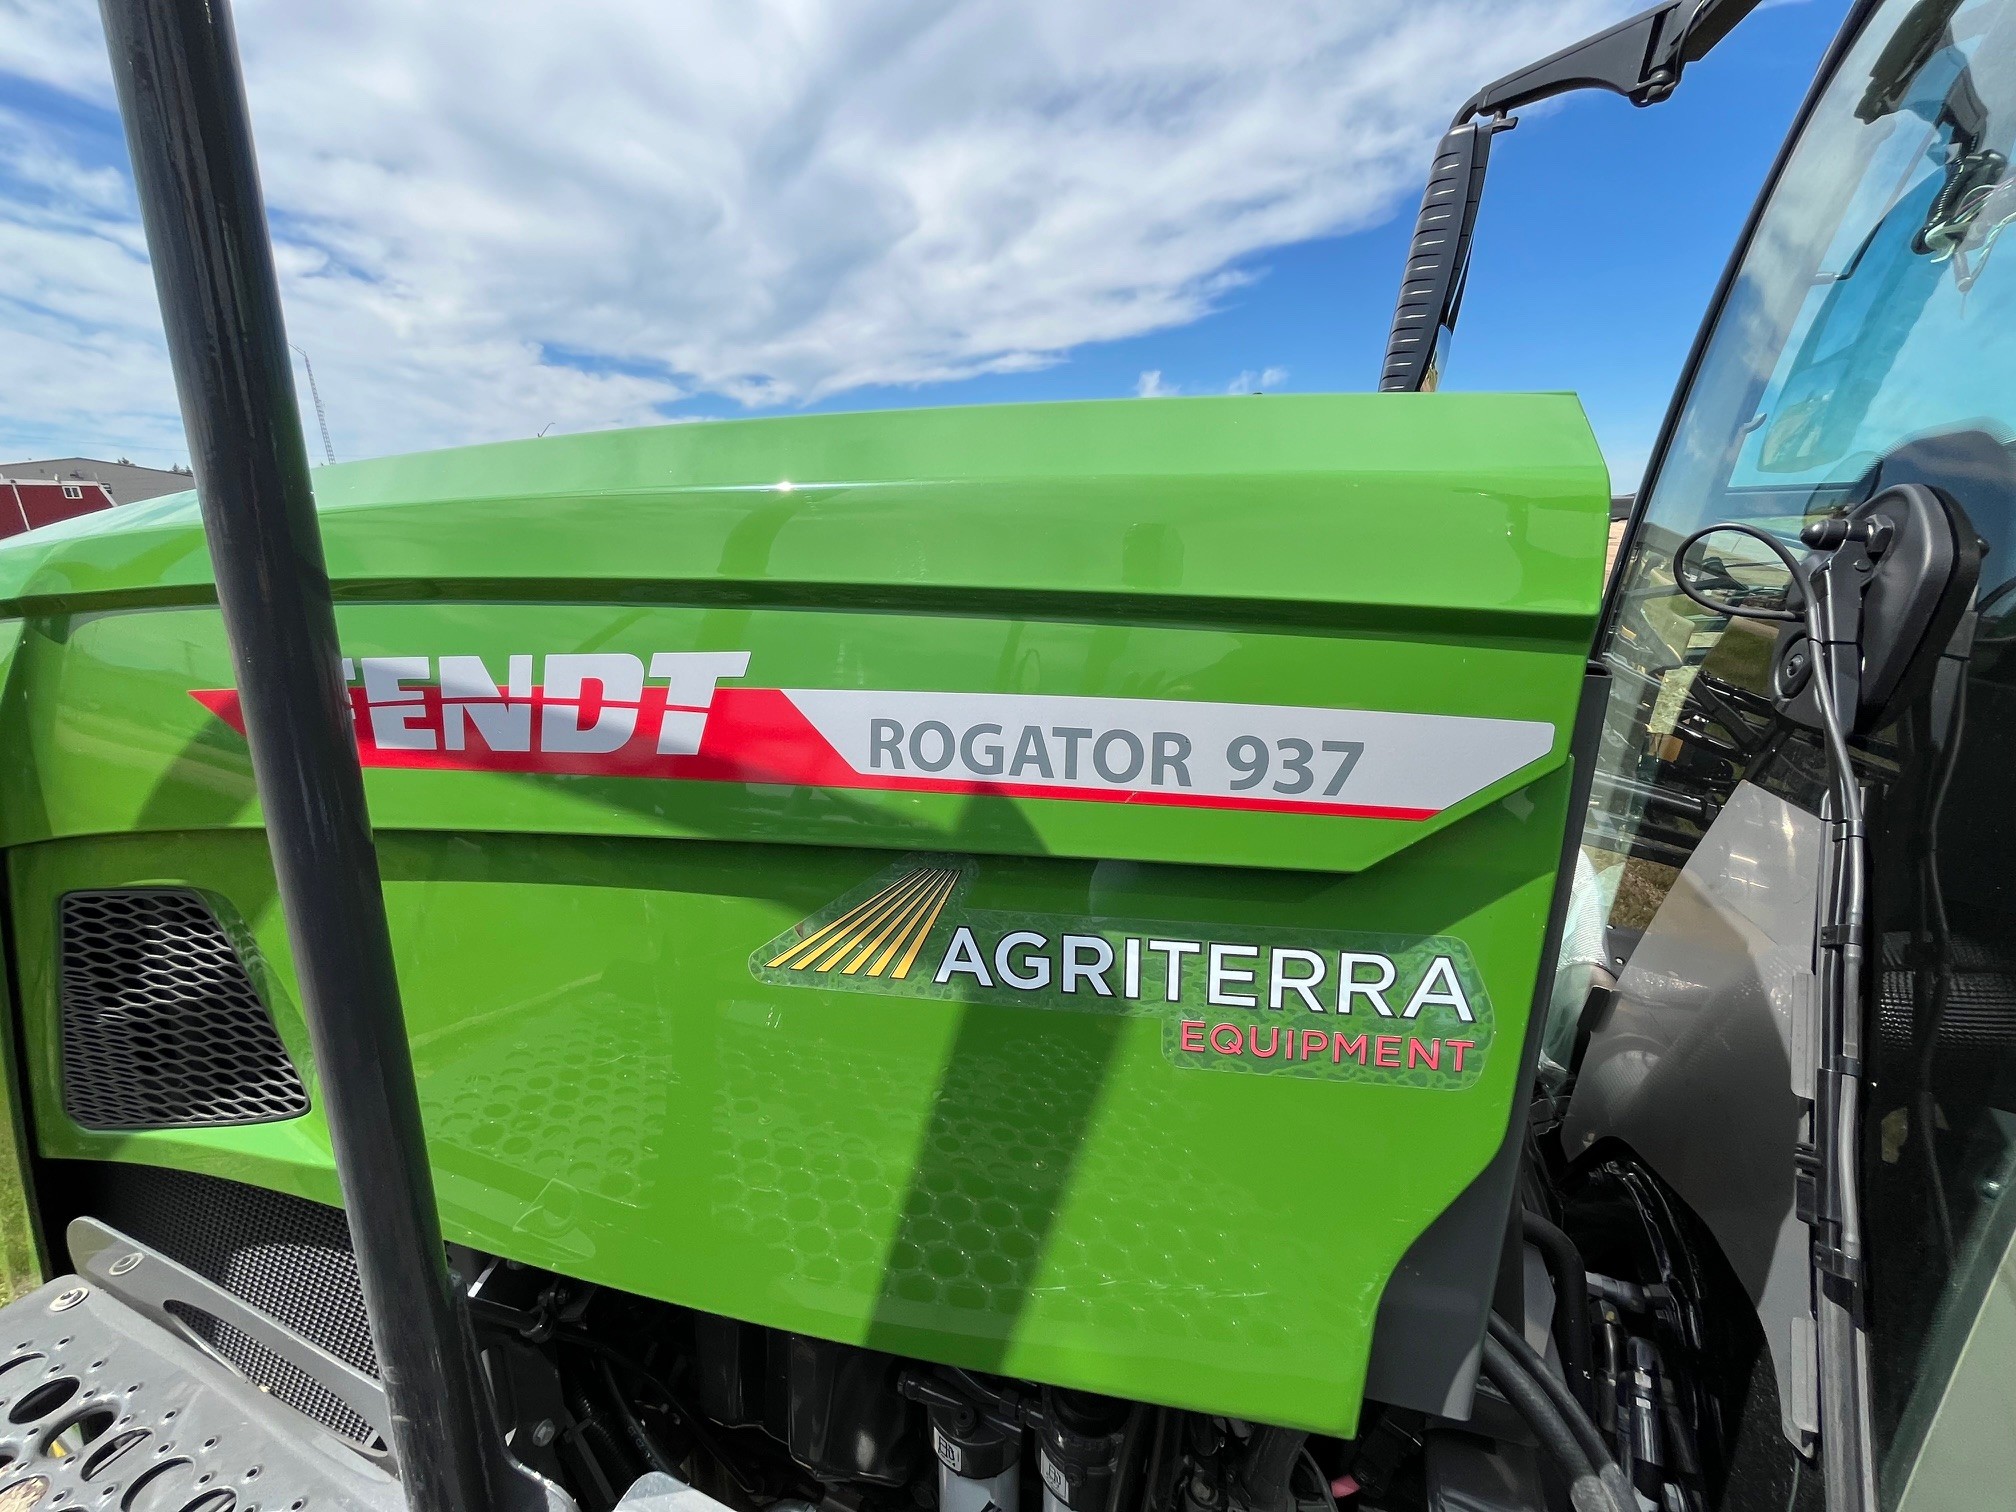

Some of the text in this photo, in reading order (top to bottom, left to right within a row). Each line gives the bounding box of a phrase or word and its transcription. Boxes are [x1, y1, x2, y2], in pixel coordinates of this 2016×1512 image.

[342, 651, 751, 755] ENDT
[869, 718, 1364, 796] ROGATOR 937
[933, 925, 1476, 1023] AGRITERRA
[1180, 1019, 1475, 1073] EQUIPMENT
